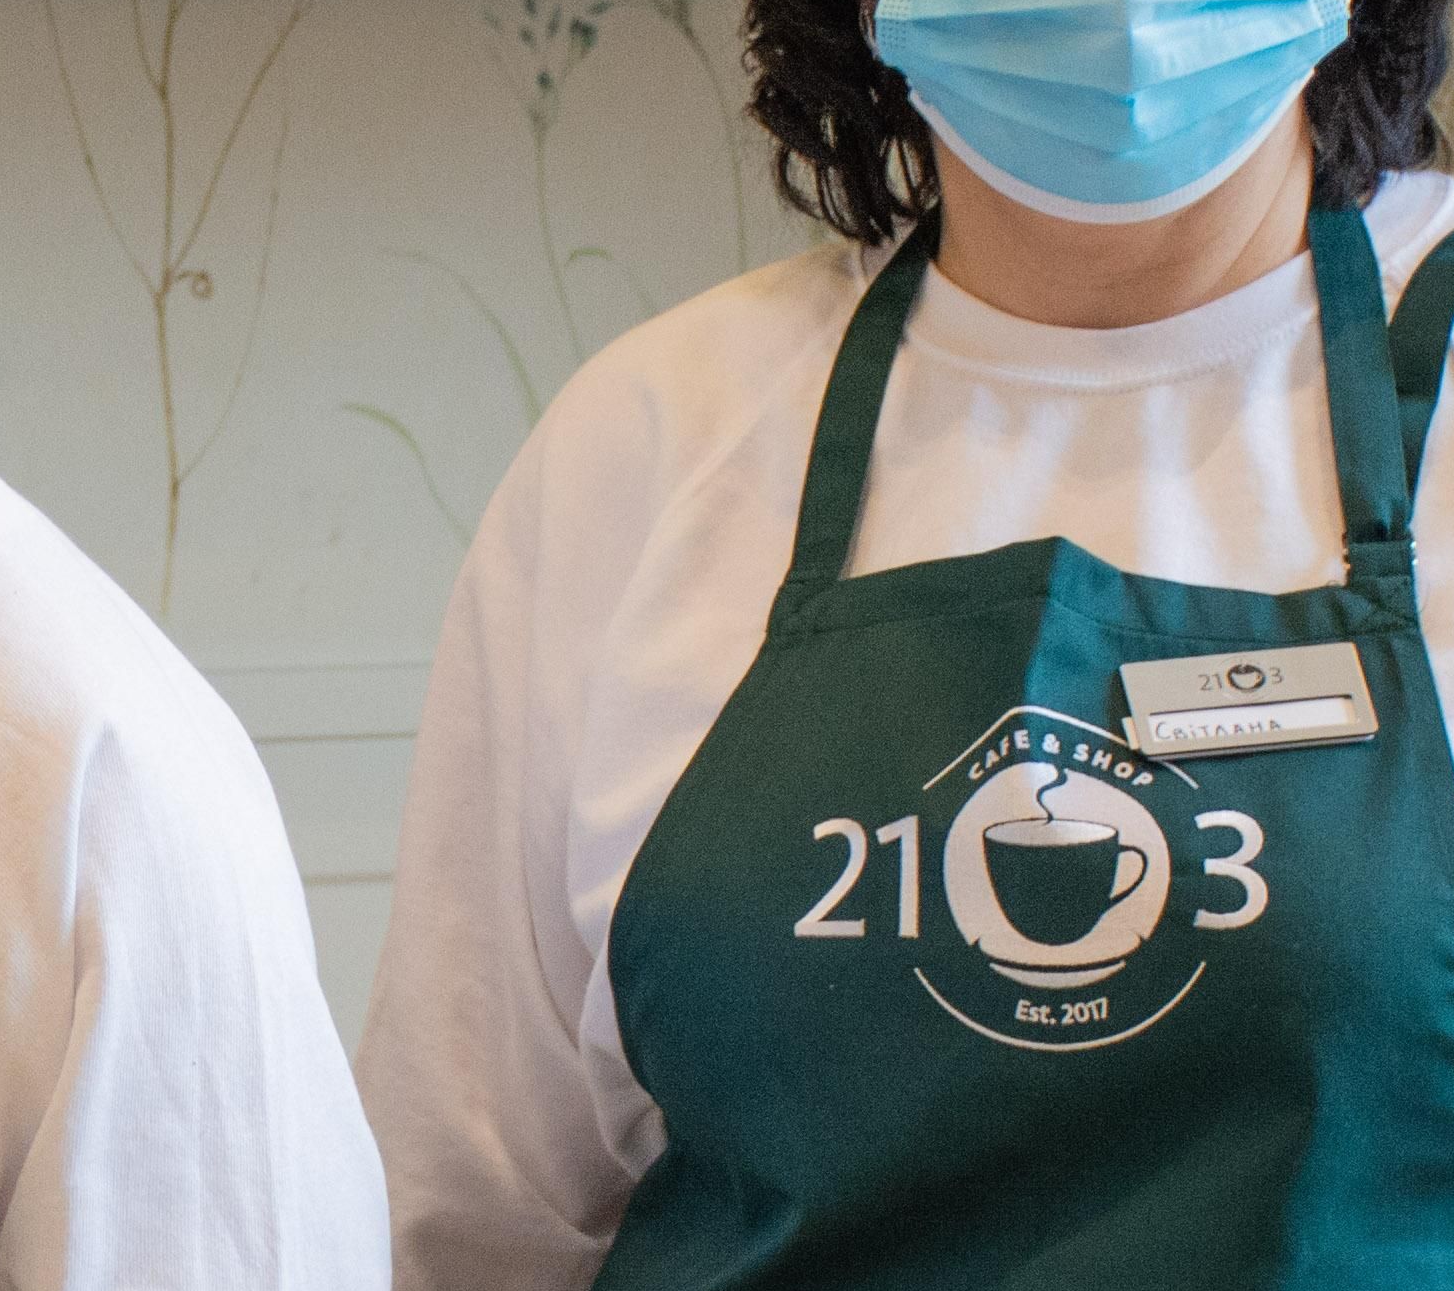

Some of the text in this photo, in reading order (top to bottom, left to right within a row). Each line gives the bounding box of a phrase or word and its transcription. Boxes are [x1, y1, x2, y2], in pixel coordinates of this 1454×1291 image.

[968, 729, 1155, 786] CAFE & SHOP
[793, 809, 1269, 939] 21 3
[1016, 996, 1110, 1026] Est. 2017
